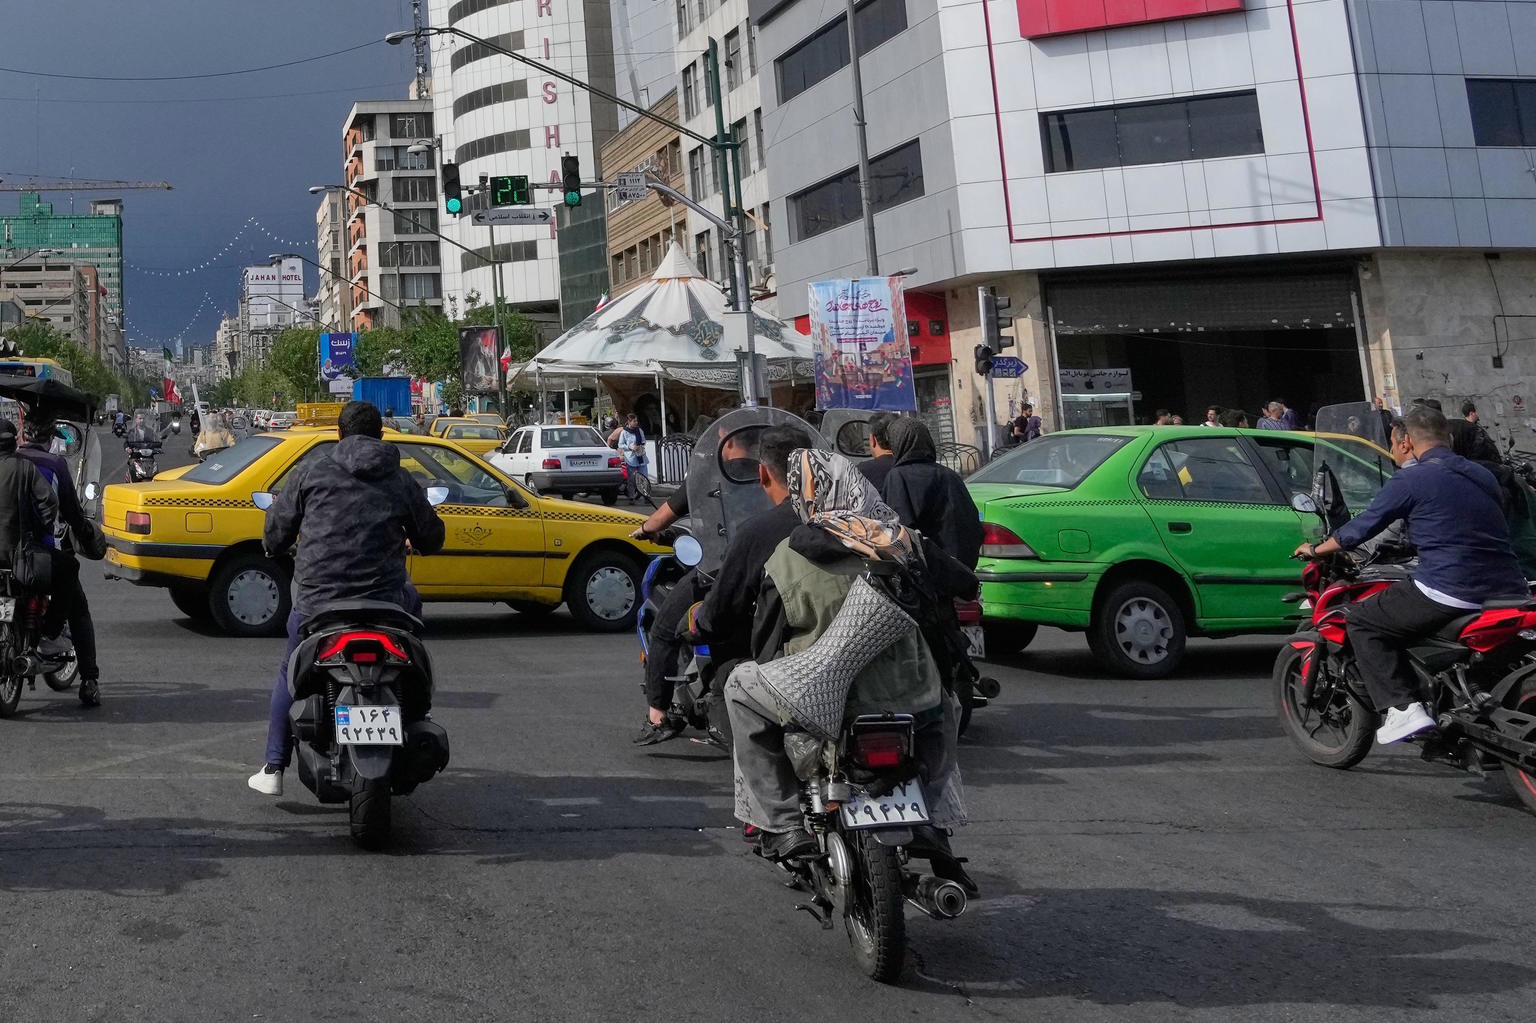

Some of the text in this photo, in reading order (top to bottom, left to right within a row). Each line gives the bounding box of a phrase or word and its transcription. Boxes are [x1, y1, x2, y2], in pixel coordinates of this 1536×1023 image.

[250, 274, 302, 282] JAHAN HOTEL
[359, 709, 390, 723] ۱۶۴
[341, 727, 398, 741] ۹۲۴۳۹
